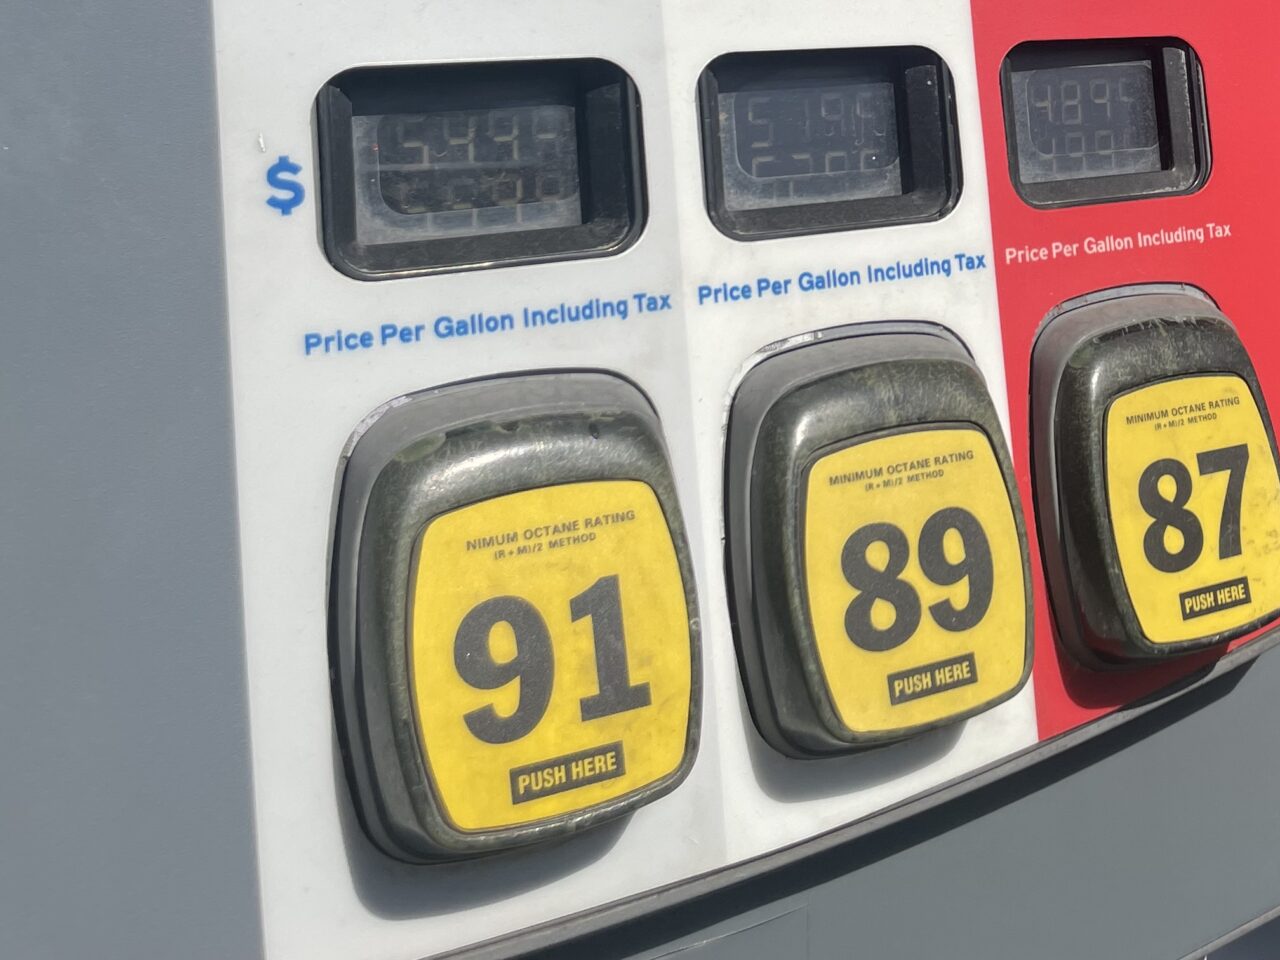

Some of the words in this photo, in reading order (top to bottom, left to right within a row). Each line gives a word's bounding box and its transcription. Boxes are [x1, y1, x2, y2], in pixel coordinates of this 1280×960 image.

[266, 155, 305, 216] $
[1005, 247, 1048, 265] Price
[1052, 241, 1080, 259] Per
[1083, 235, 1133, 254] Gallon
[1137, 226, 1204, 248] Including
[1206, 223, 1231, 238] Tax
[698, 281, 753, 305] Price
[757, 277, 791, 297] Per
[797, 266, 861, 291] Gallon
[867, 257, 951, 281] Including
[954, 252, 987, 271] Tax
[304, 330, 374, 355] Price
[381, 323, 425, 346] Per
[433, 308, 515, 338] Gallon
[523, 296, 629, 329] Including
[633, 293, 673, 312] Tax
[1126, 409, 1169, 425] MINIMUM
[1171, 402, 1207, 417] OCTANE
[1209, 396, 1240, 410] RATING
[1187, 412, 1218, 424] METHOD
[829, 467, 883, 486] MINIMUM
[887, 458, 931, 475] OCTANE
[934, 450, 974, 467] RATING
[907, 470, 944, 484] METHOD
[524, 521, 580, 541] OCTANE
[584, 509, 636, 530] RATING
[1138, 443, 1250, 573] 87
[548, 532, 597, 549] METHOD
[841, 506, 994, 652] 89
[1184, 592, 1215, 614] PUSH
[1217, 583, 1246, 605] HERE
[453, 573, 652, 745] 91
[894, 675, 932, 698] PUSH
[936, 661, 971, 686] HERE
[518, 768, 567, 794] PUSH
[572, 751, 617, 783] HERE
